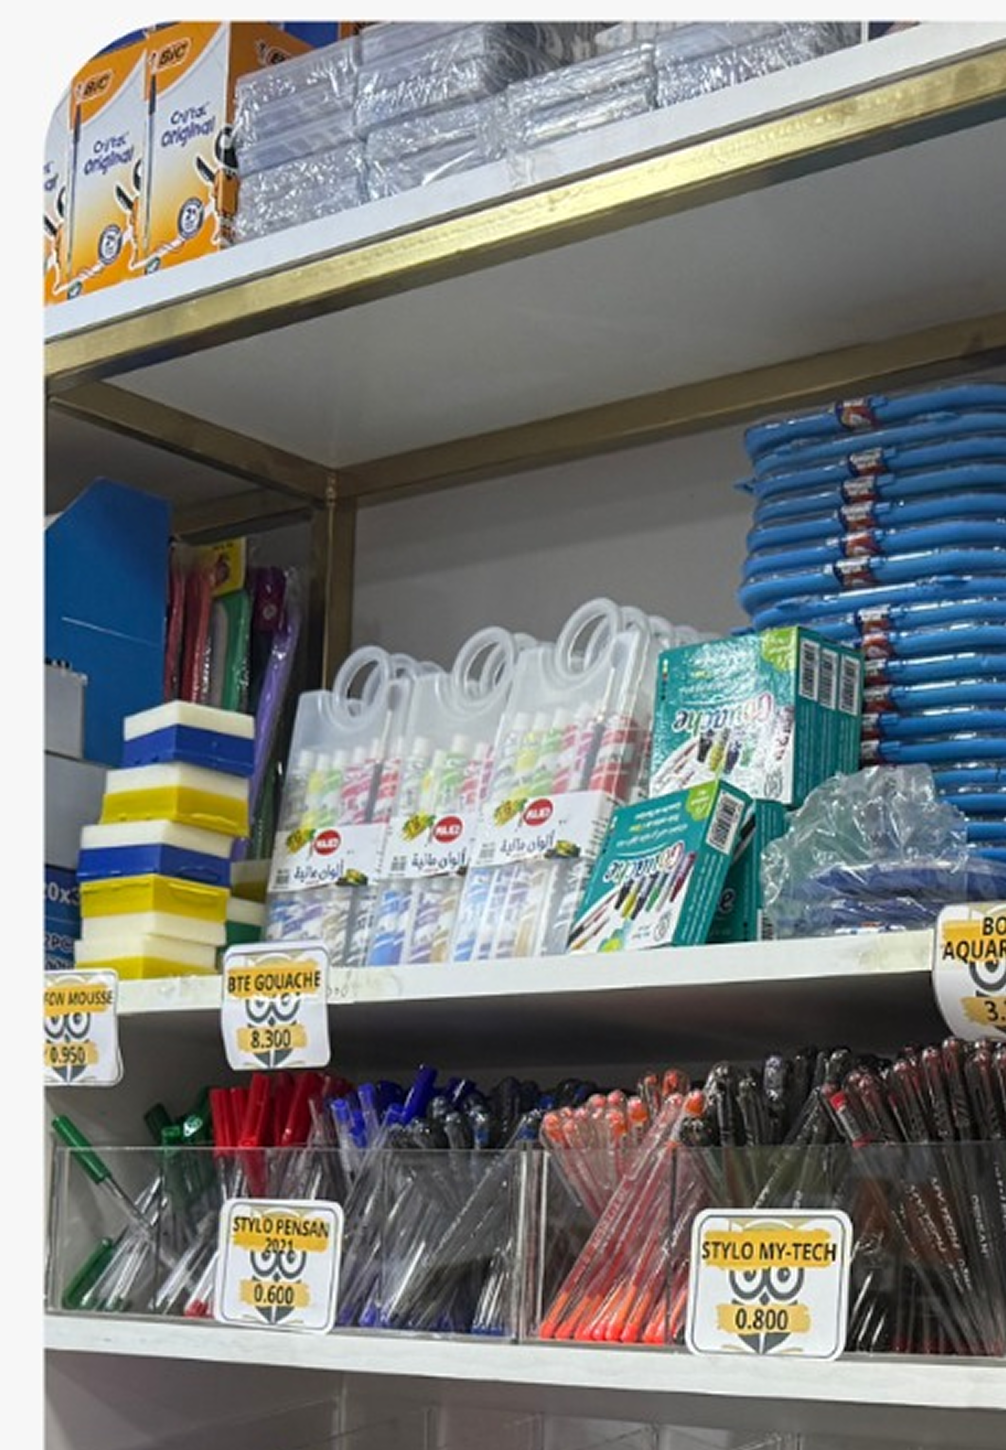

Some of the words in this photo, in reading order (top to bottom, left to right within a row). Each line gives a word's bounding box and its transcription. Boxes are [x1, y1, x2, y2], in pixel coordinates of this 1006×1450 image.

[161, 115, 215, 148] Original
[227, 976, 251, 994] BTE
[254, 969, 322, 992] GOUACHE
[66, 990, 114, 1008] MOUSSE
[250, 1029, 292, 1049] 8.300
[49, 1046, 87, 1064] 0.950
[233, 1215, 274, 1235] STYLO
[275, 1218, 330, 1239] PENSAN
[264, 1237, 294, 1254] 2021
[701, 1240, 754, 1261] STYLO
[758, 1242, 837, 1262] MY-TECH
[254, 1283, 295, 1305] 0.600
[735, 1307, 789, 1331] 0.800
